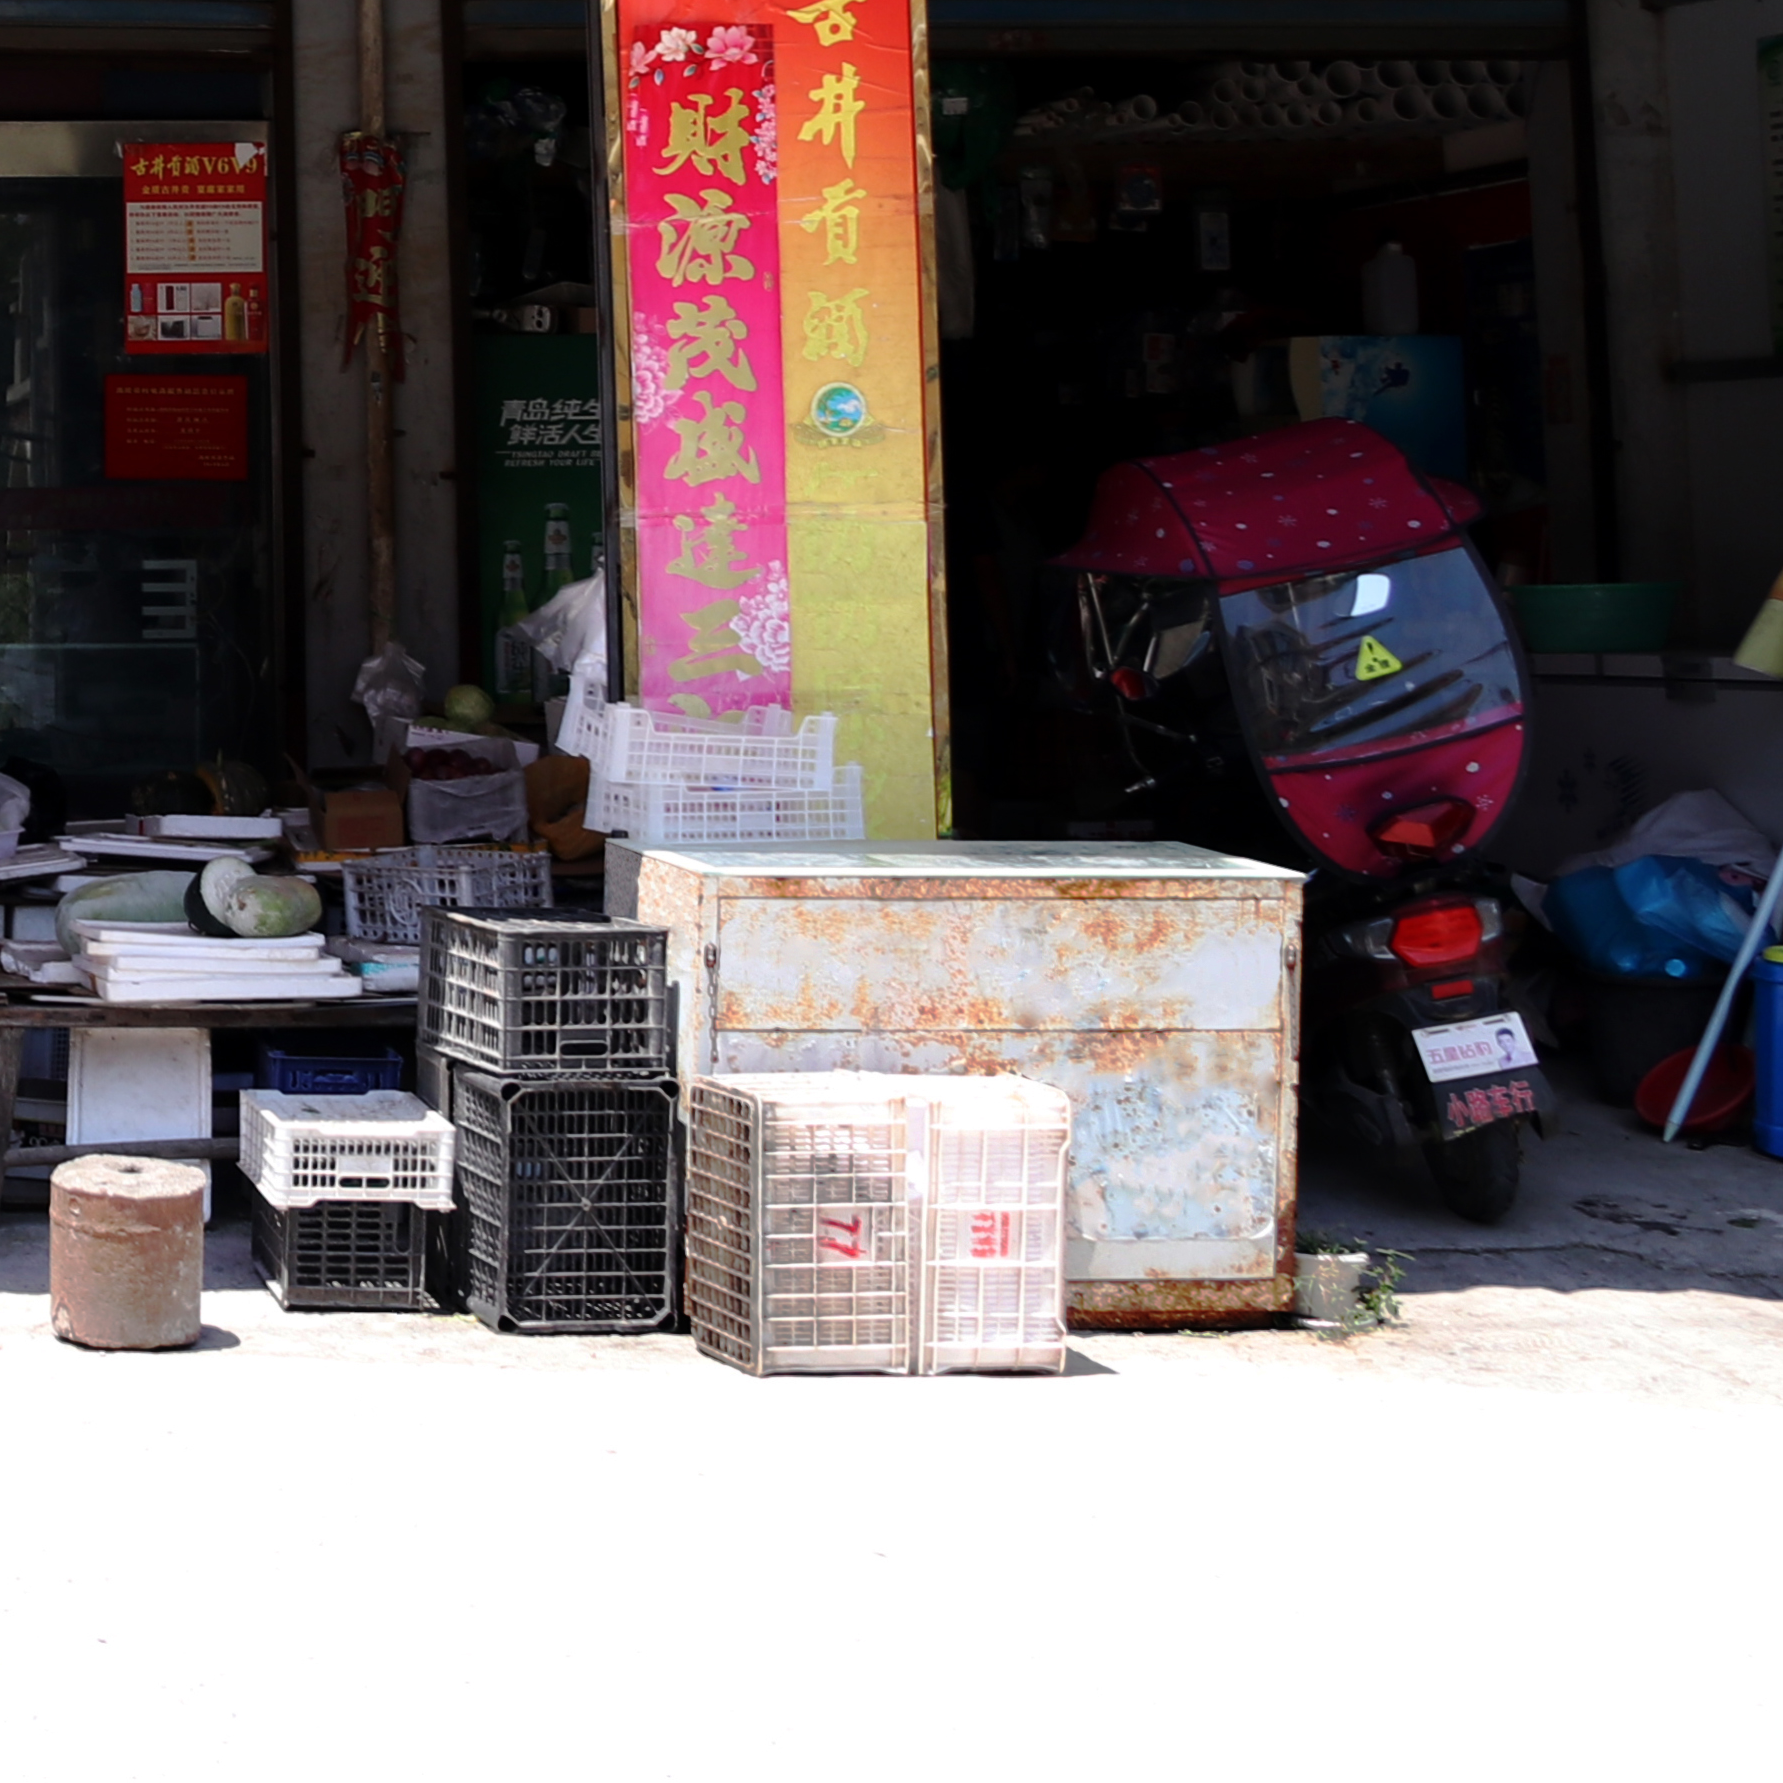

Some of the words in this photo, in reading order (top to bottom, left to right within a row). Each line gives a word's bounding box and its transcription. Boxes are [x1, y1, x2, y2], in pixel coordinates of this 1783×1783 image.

[500, 397, 602, 428] 青岛纯生
[507, 422, 602, 446] 鲜活人生
